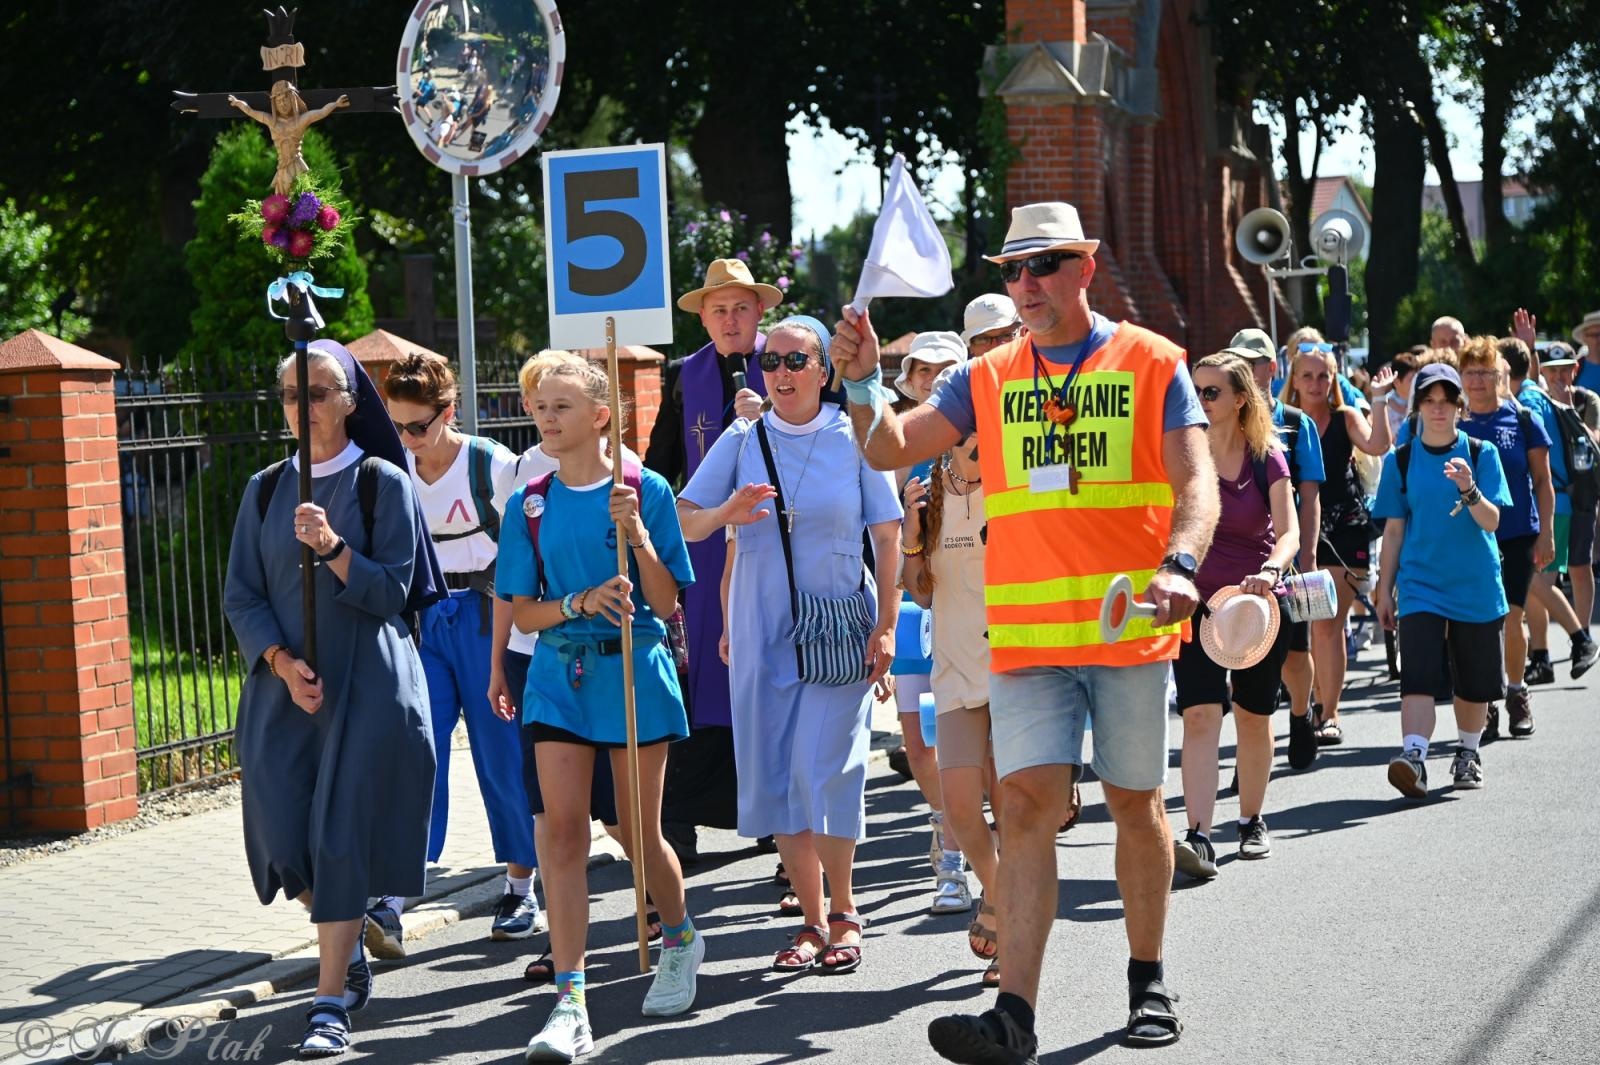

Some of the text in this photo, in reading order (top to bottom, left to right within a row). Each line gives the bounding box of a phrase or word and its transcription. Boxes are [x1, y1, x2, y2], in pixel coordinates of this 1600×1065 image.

[264, 46, 299, 68] INRI
[564, 167, 648, 297] 5
[1004, 383, 1130, 424] KIERWANIE
[605, 527, 617, 550] 5
